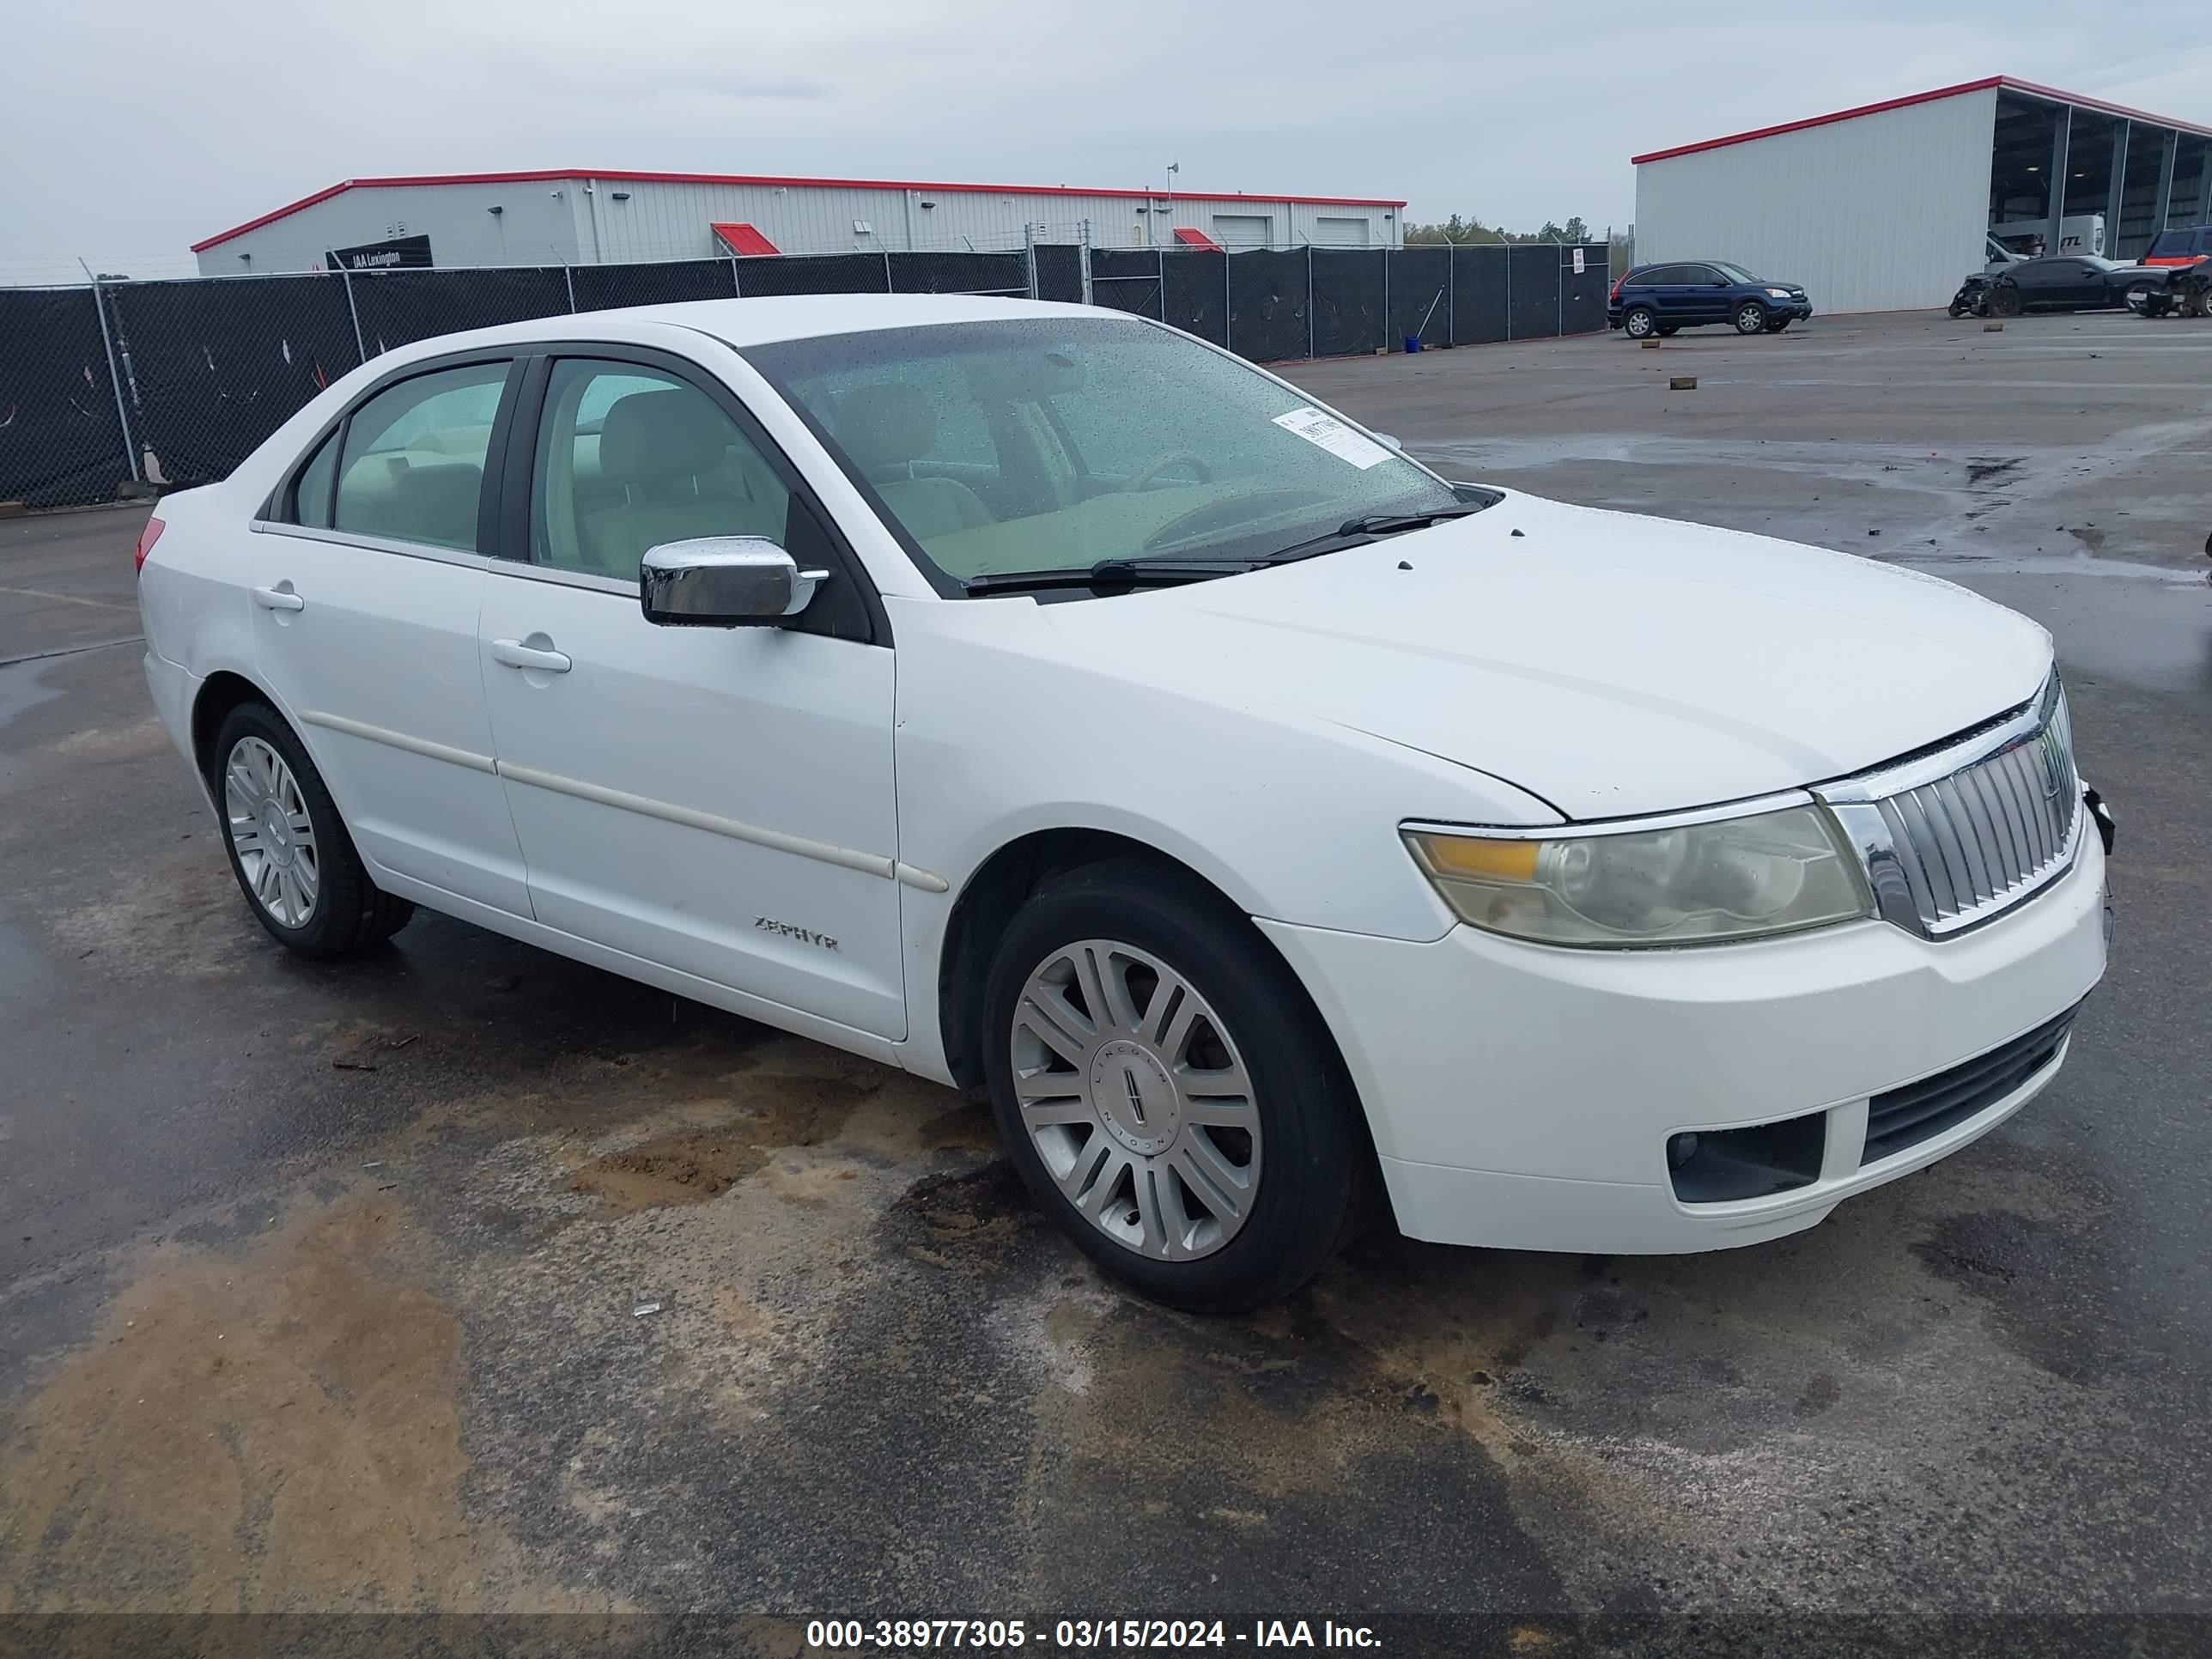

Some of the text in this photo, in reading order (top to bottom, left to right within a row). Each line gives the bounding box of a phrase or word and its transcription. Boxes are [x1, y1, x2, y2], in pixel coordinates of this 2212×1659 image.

[353, 251, 400, 268] IAA Lexington
[751, 914, 842, 953] ZEPHYR
[1095, 1046, 1167, 1085] LINCOLN
